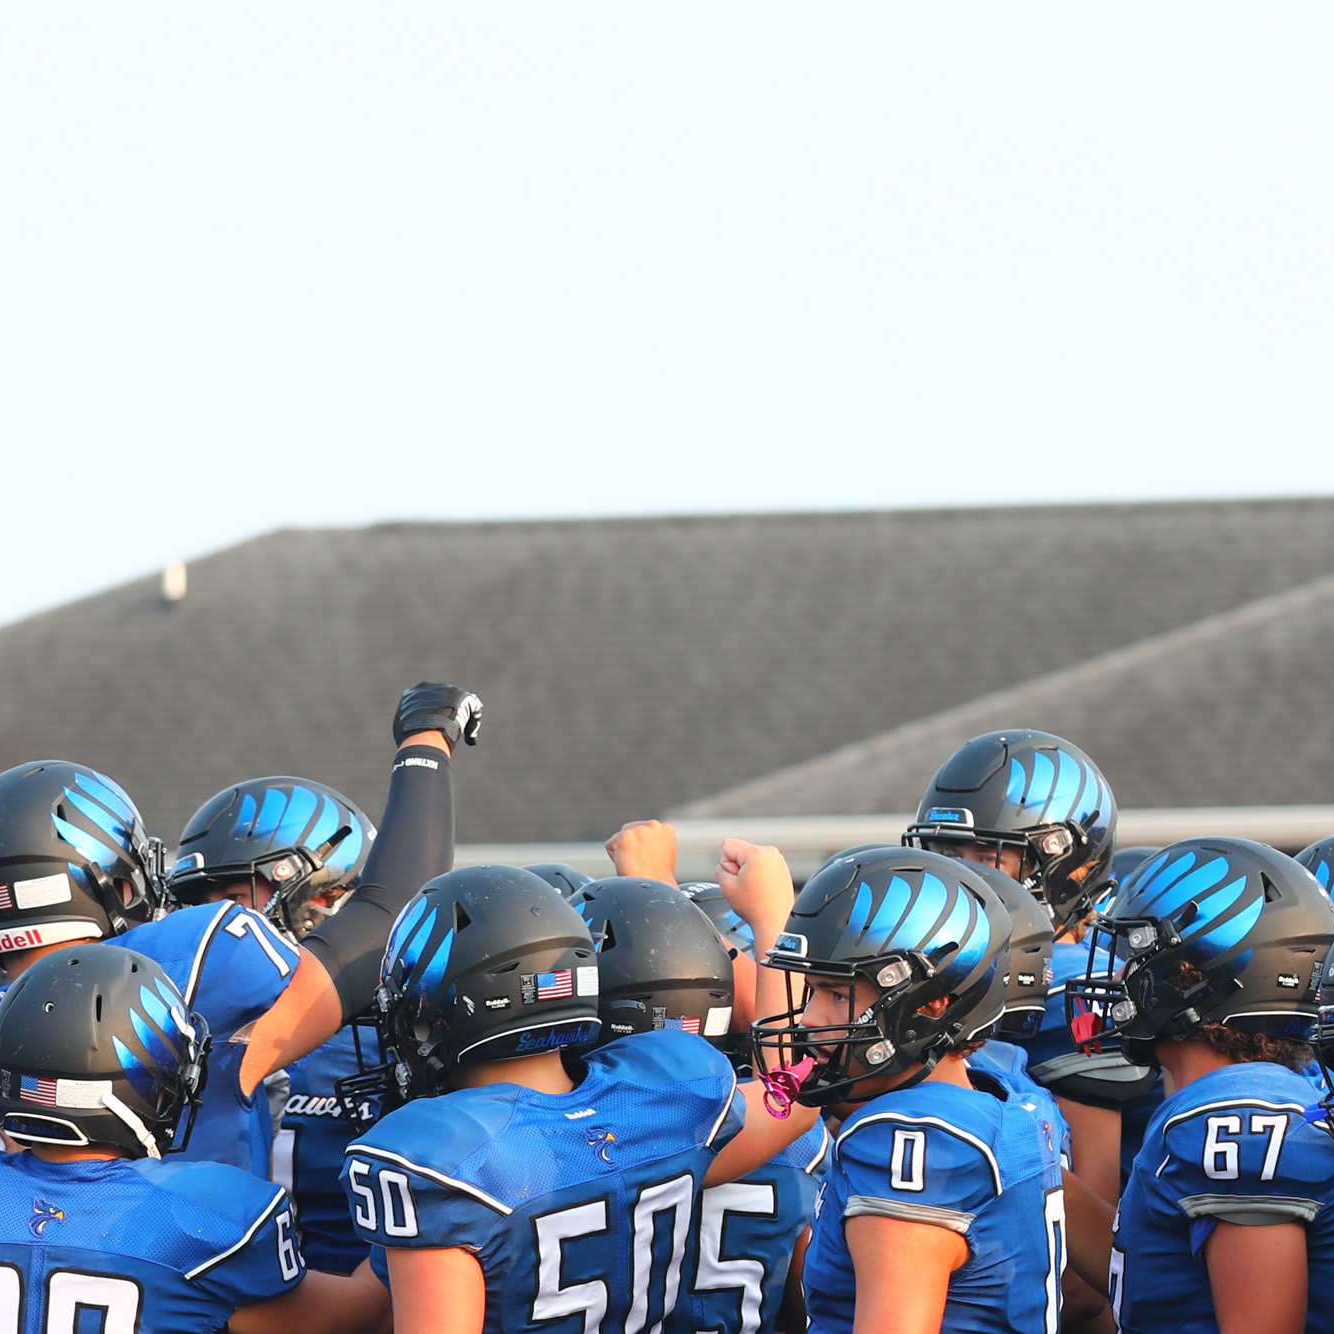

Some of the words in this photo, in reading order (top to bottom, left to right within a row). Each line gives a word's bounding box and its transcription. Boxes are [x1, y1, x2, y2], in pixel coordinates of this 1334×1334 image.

[514, 1023, 590, 1052] Seahawks
[890, 1129, 927, 1193] 0
[1202, 1114, 1288, 1182] 67
[347, 1158, 420, 1238] 50
